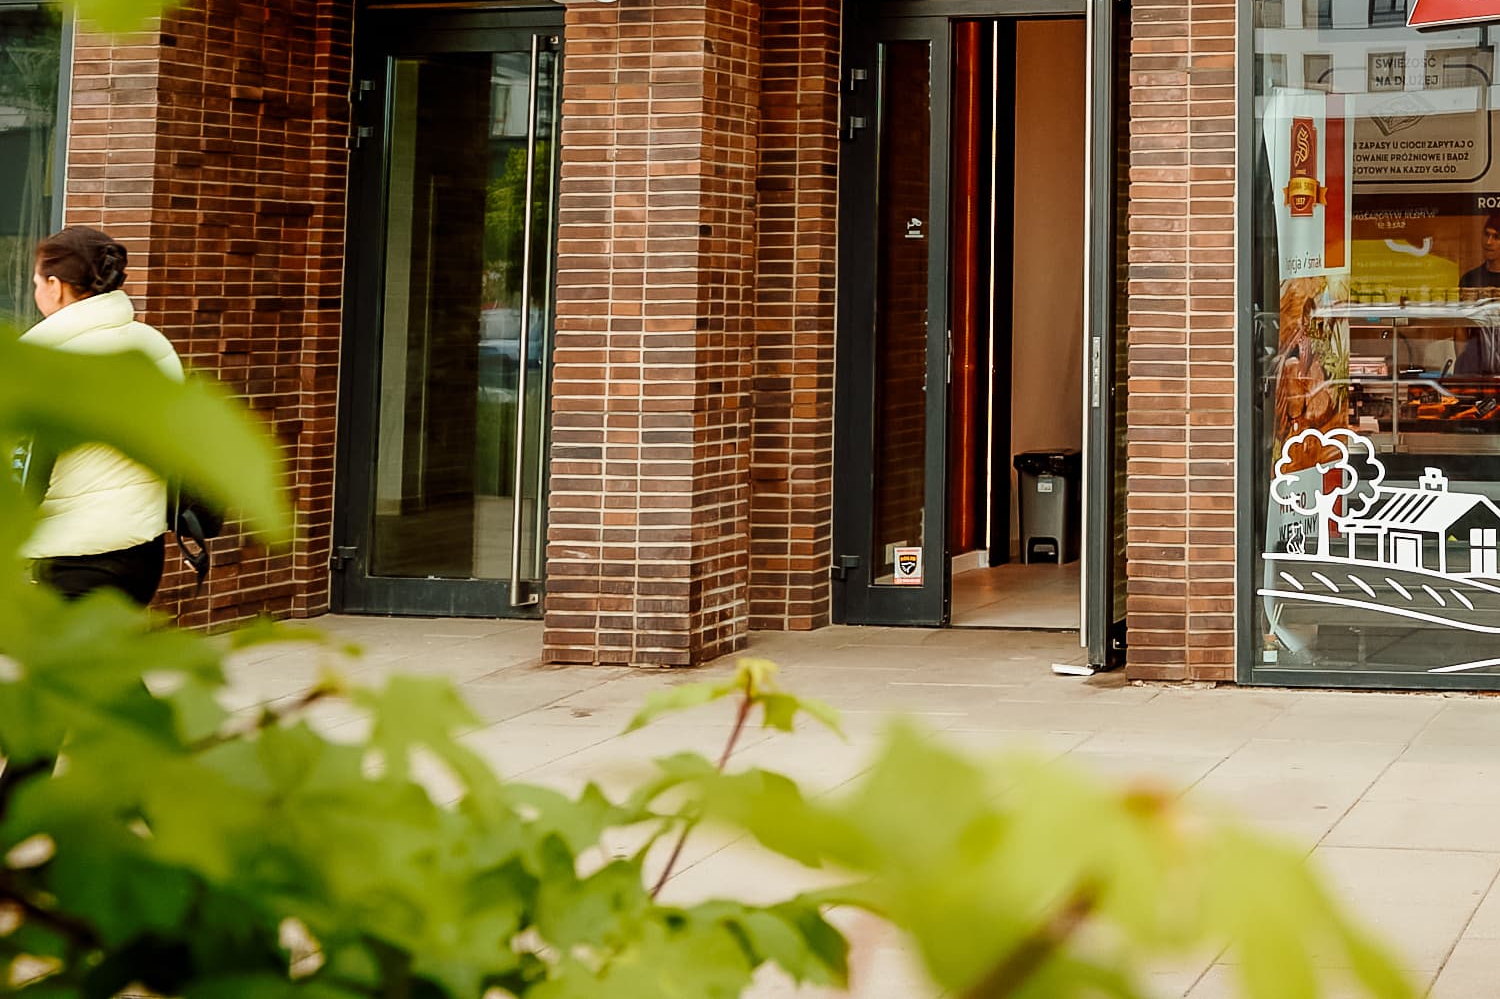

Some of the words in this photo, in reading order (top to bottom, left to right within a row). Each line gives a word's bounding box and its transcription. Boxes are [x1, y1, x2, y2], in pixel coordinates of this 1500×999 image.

[1375, 76, 1391, 86] NA
[1360, 141, 1391, 150] ZAPASY
[1392, 141, 1398, 149] U
[1427, 140, 1466, 149] ZAPYTAJ
[1467, 140, 1474, 148] O
[1353, 154, 1389, 163] OWANIE
[1390, 166, 1401, 174] NA
